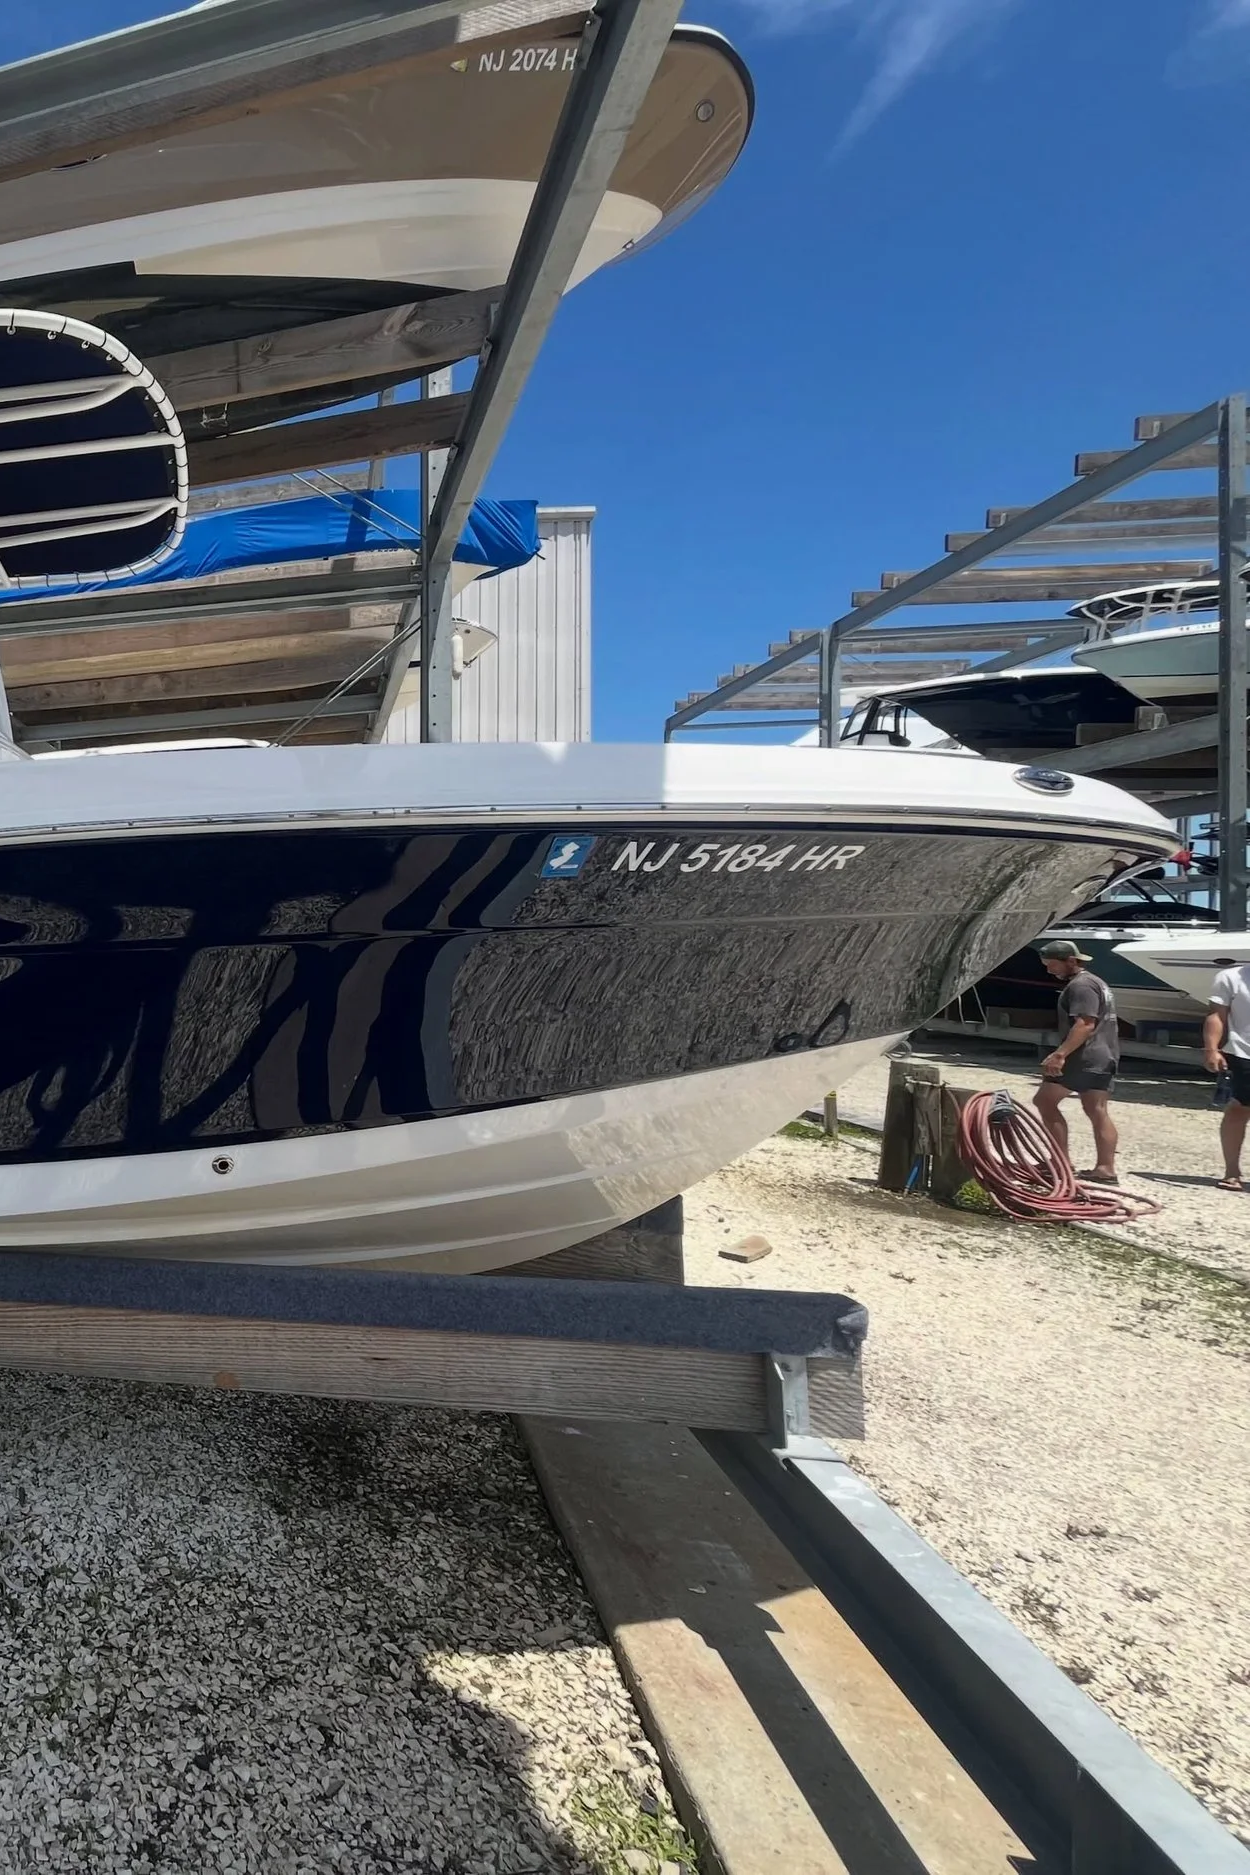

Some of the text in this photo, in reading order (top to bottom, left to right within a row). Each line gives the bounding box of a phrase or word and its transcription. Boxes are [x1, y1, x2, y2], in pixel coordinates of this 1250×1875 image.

[478, 51, 506, 72] NJ
[508, 47, 558, 72] 2074
[611, 841, 866, 873] NJ 5184 HR
